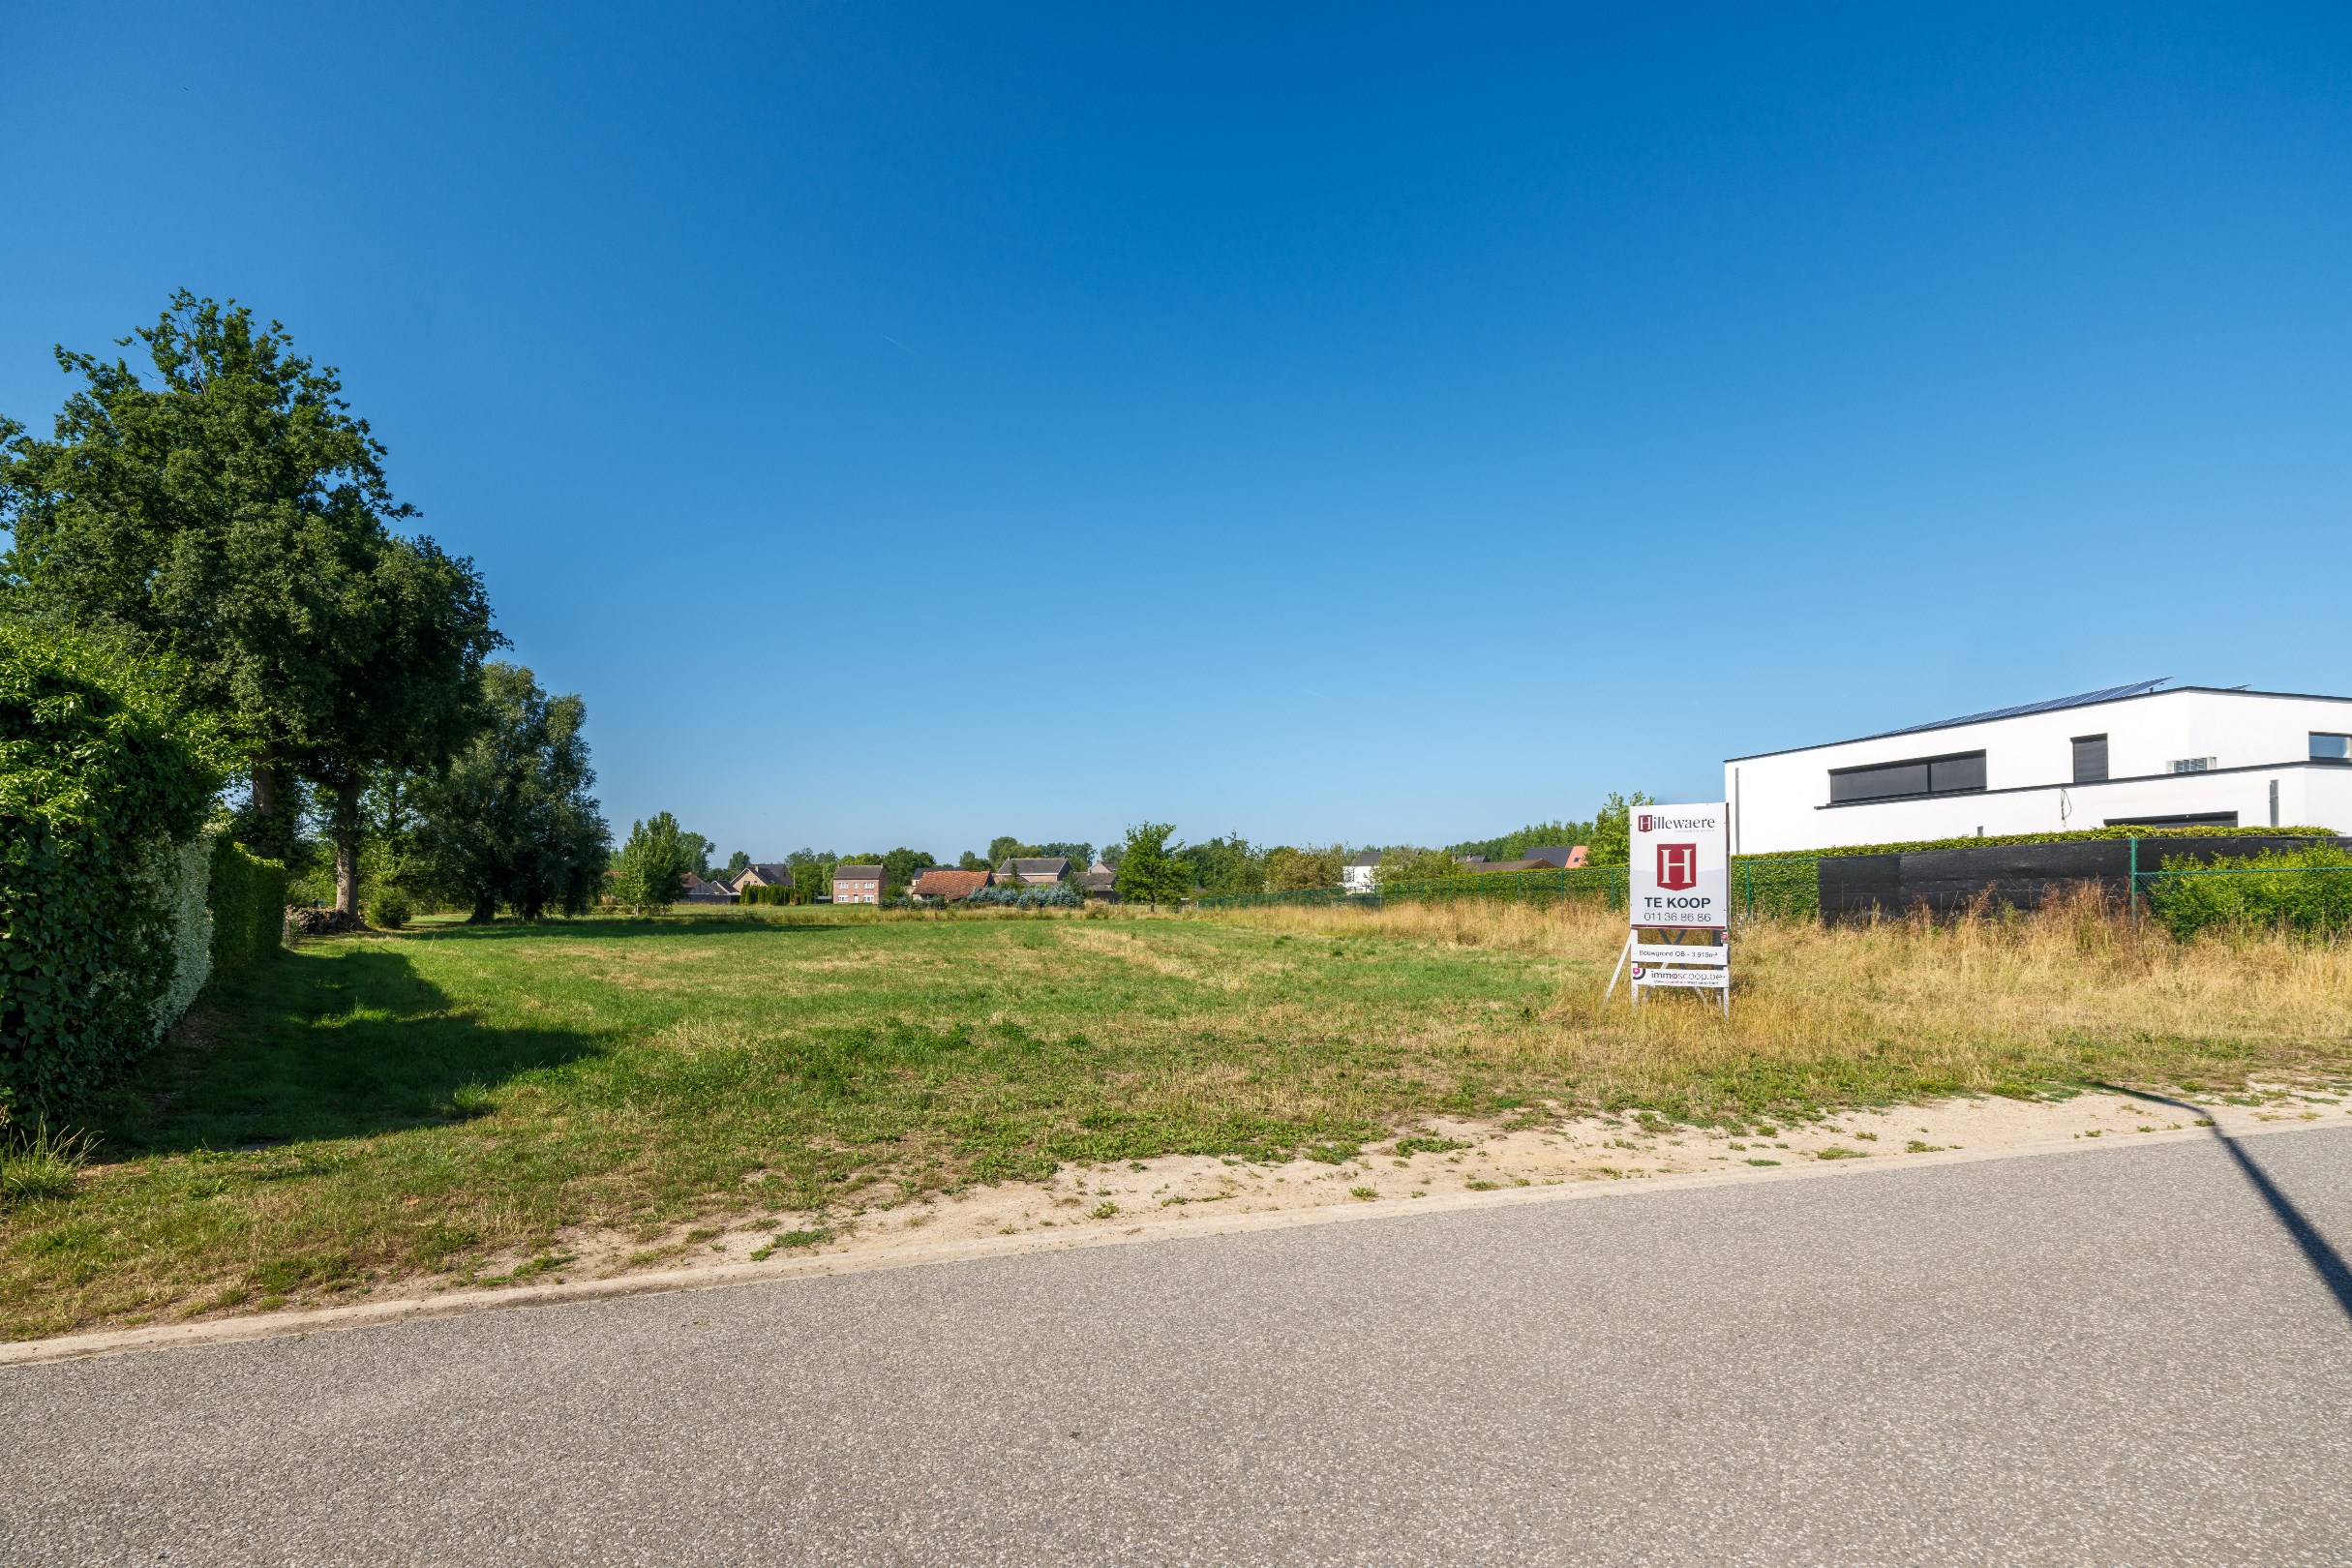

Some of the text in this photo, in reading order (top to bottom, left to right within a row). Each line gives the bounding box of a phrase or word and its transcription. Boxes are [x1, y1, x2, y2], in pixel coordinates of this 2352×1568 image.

[1639, 815, 1715, 832] Hillewaere
[1660, 849, 1693, 883] H
[1644, 897, 1711, 908] TE KOOP
[1665, 913, 1677, 921] 36
[1651, 971, 1723, 981] immoscoop.be
